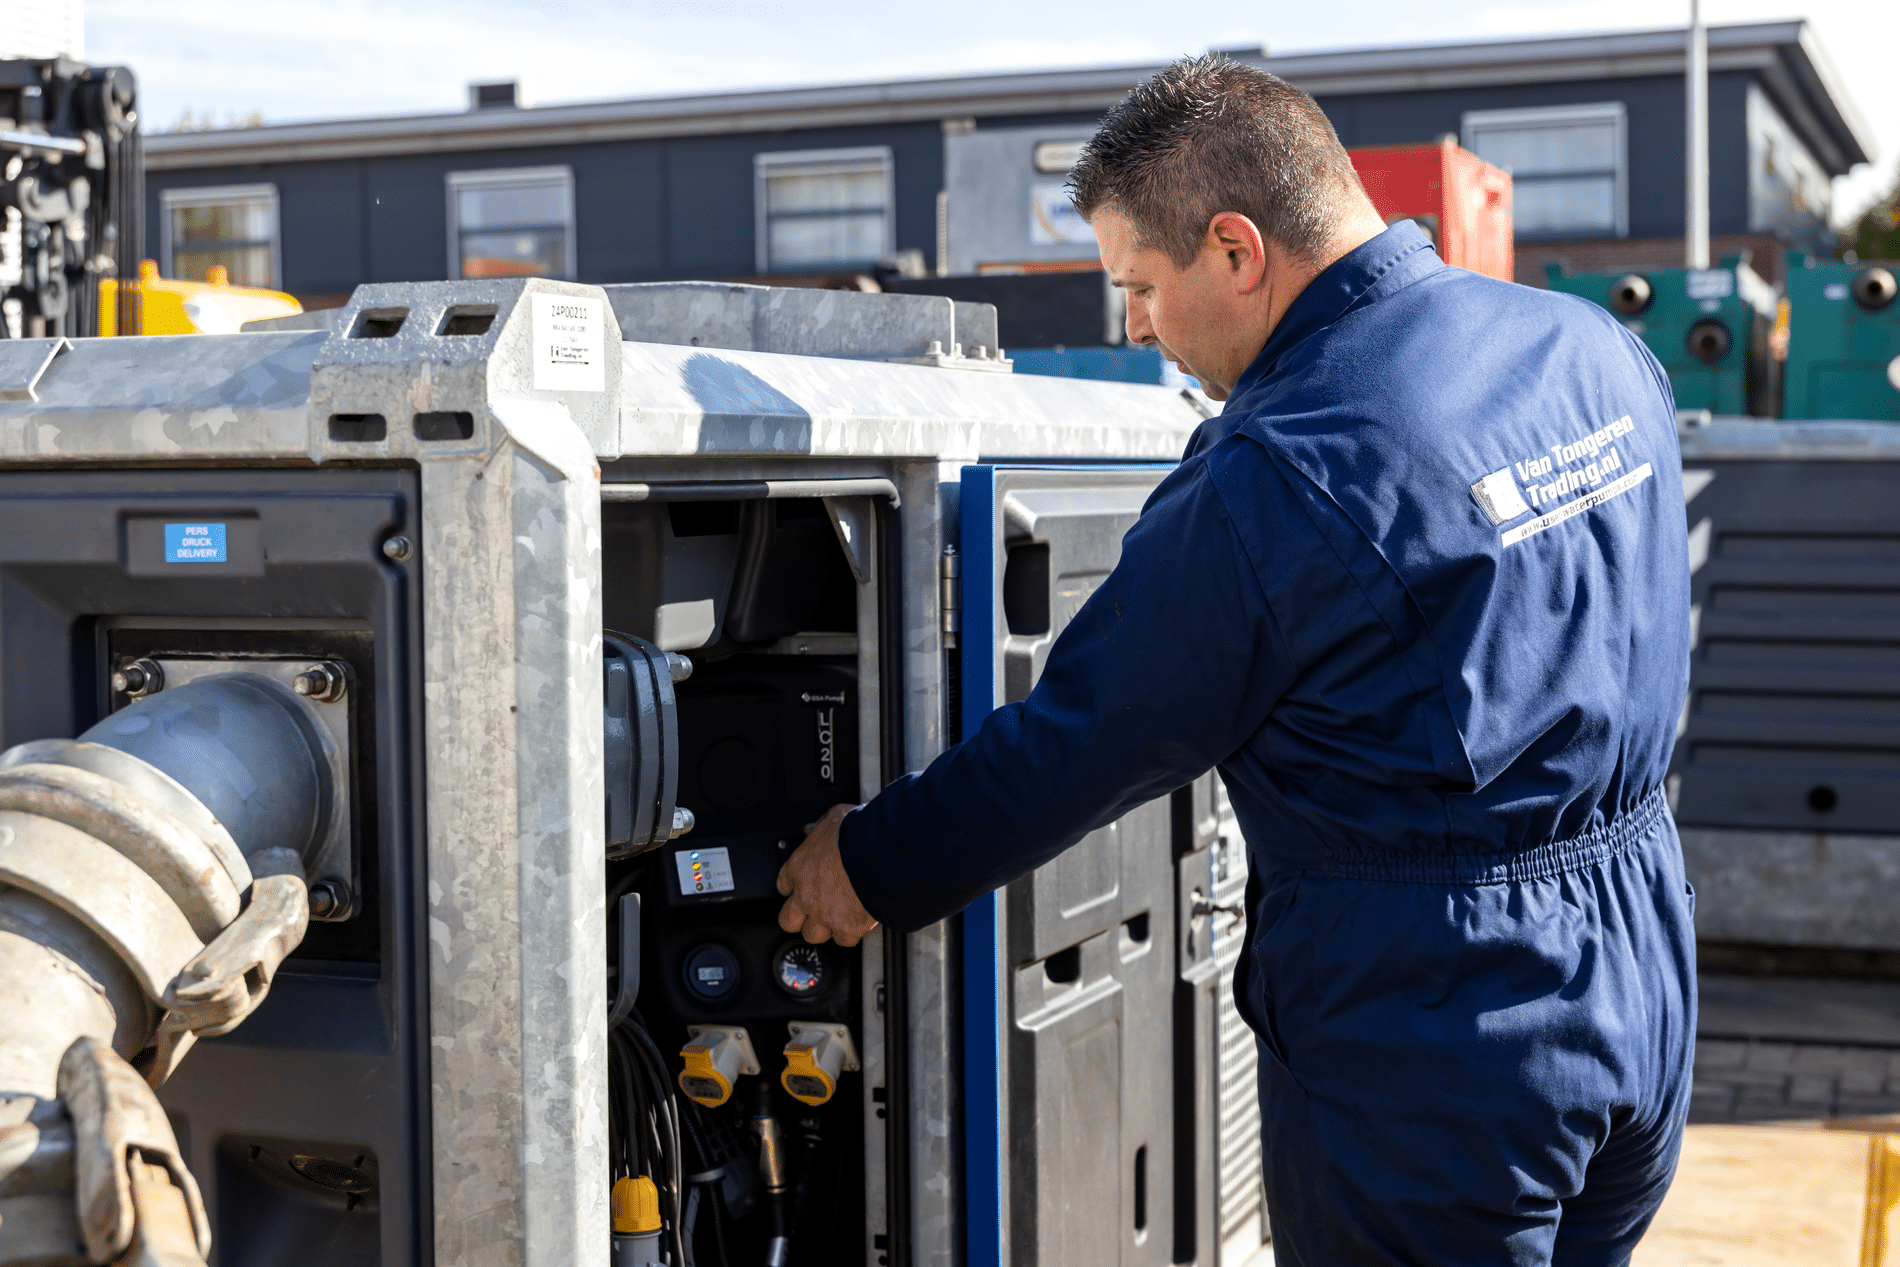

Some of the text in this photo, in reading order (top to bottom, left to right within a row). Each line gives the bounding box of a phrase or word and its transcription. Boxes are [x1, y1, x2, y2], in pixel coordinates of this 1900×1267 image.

[551, 305, 587, 319] 24P00211
[1515, 414, 1635, 482] Van Tongeren
[1525, 446, 1621, 507] Trading.nl
[185, 526, 209, 536] PERS
[182, 537, 212, 547] DRUCK
[177, 548, 218, 558] DELIVERY
[820, 712, 832, 779] LC20
